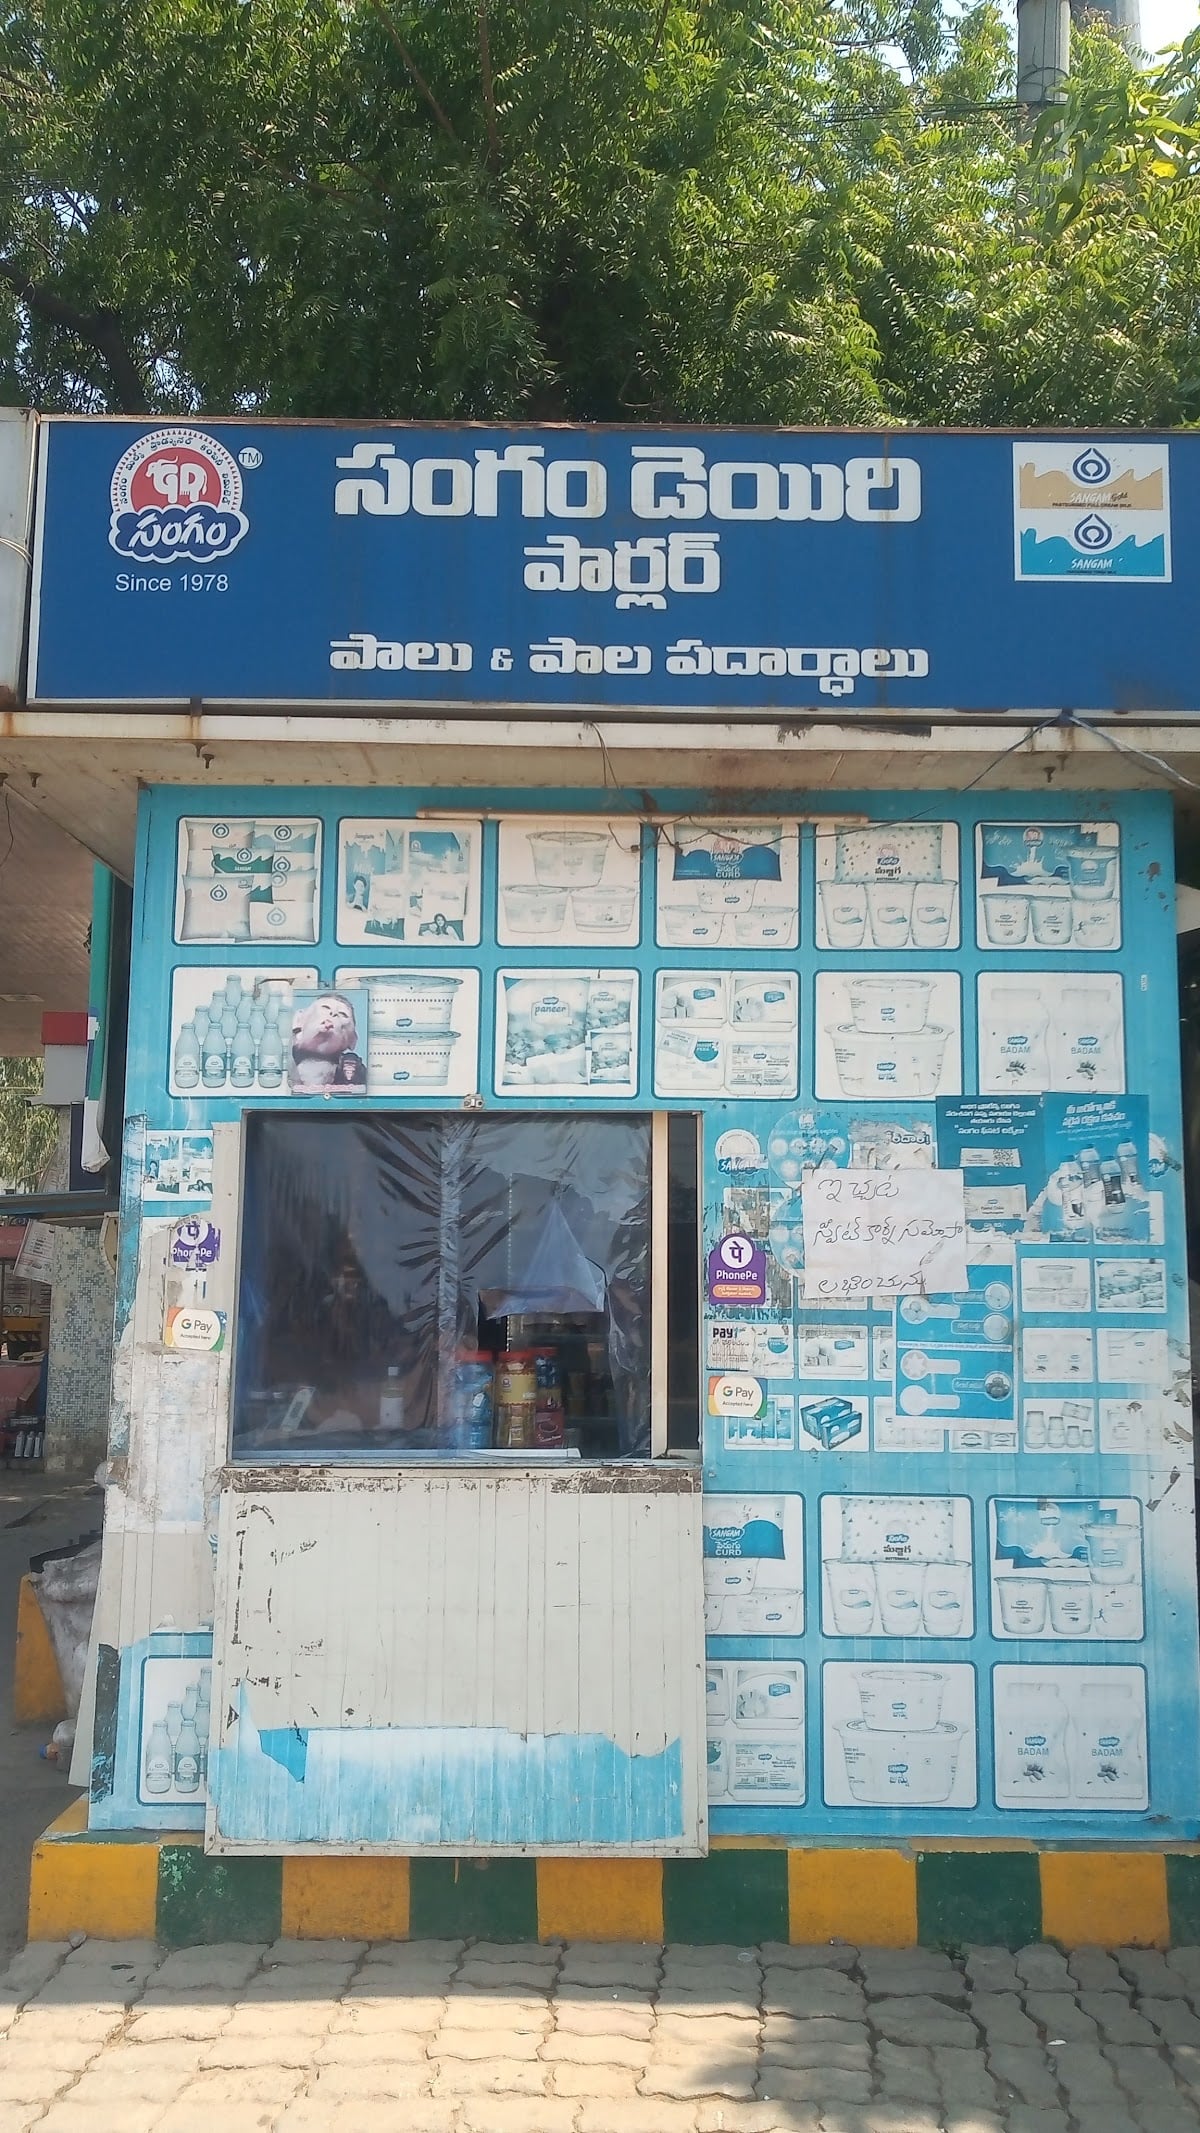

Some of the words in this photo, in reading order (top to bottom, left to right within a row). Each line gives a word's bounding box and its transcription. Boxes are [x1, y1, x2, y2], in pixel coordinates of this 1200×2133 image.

[241, 453, 261, 463] TM
[335, 443, 608, 519] సంగం
[1071, 492, 1112, 504] SANGAM
[128, 512, 227, 548] సంగం
[1071, 558, 1113, 570] SANGAM
[523, 532, 721, 610] పార్లర్
[115, 573, 172, 592] Since
[180, 573, 229, 592] 1978
[329, 633, 473, 672] పాలు
[490, 648, 514, 671] &
[529, 636, 653, 675] పాల
[1071, 1047, 1101, 1055] BADAM
[715, 1269, 758, 1281] PhonePe
[181, 1318, 192, 1330] G
[193, 1319, 213, 1334] Pay
[722, 1386, 734, 1397] G
[735, 1386, 755, 1401] Pay
[711, 1530, 742, 1538] SANGAM
[715, 1549, 742, 1557] CURD
[1017, 1747, 1050, 1756] BADAM
[1091, 1748, 1124, 1757] BADAM
